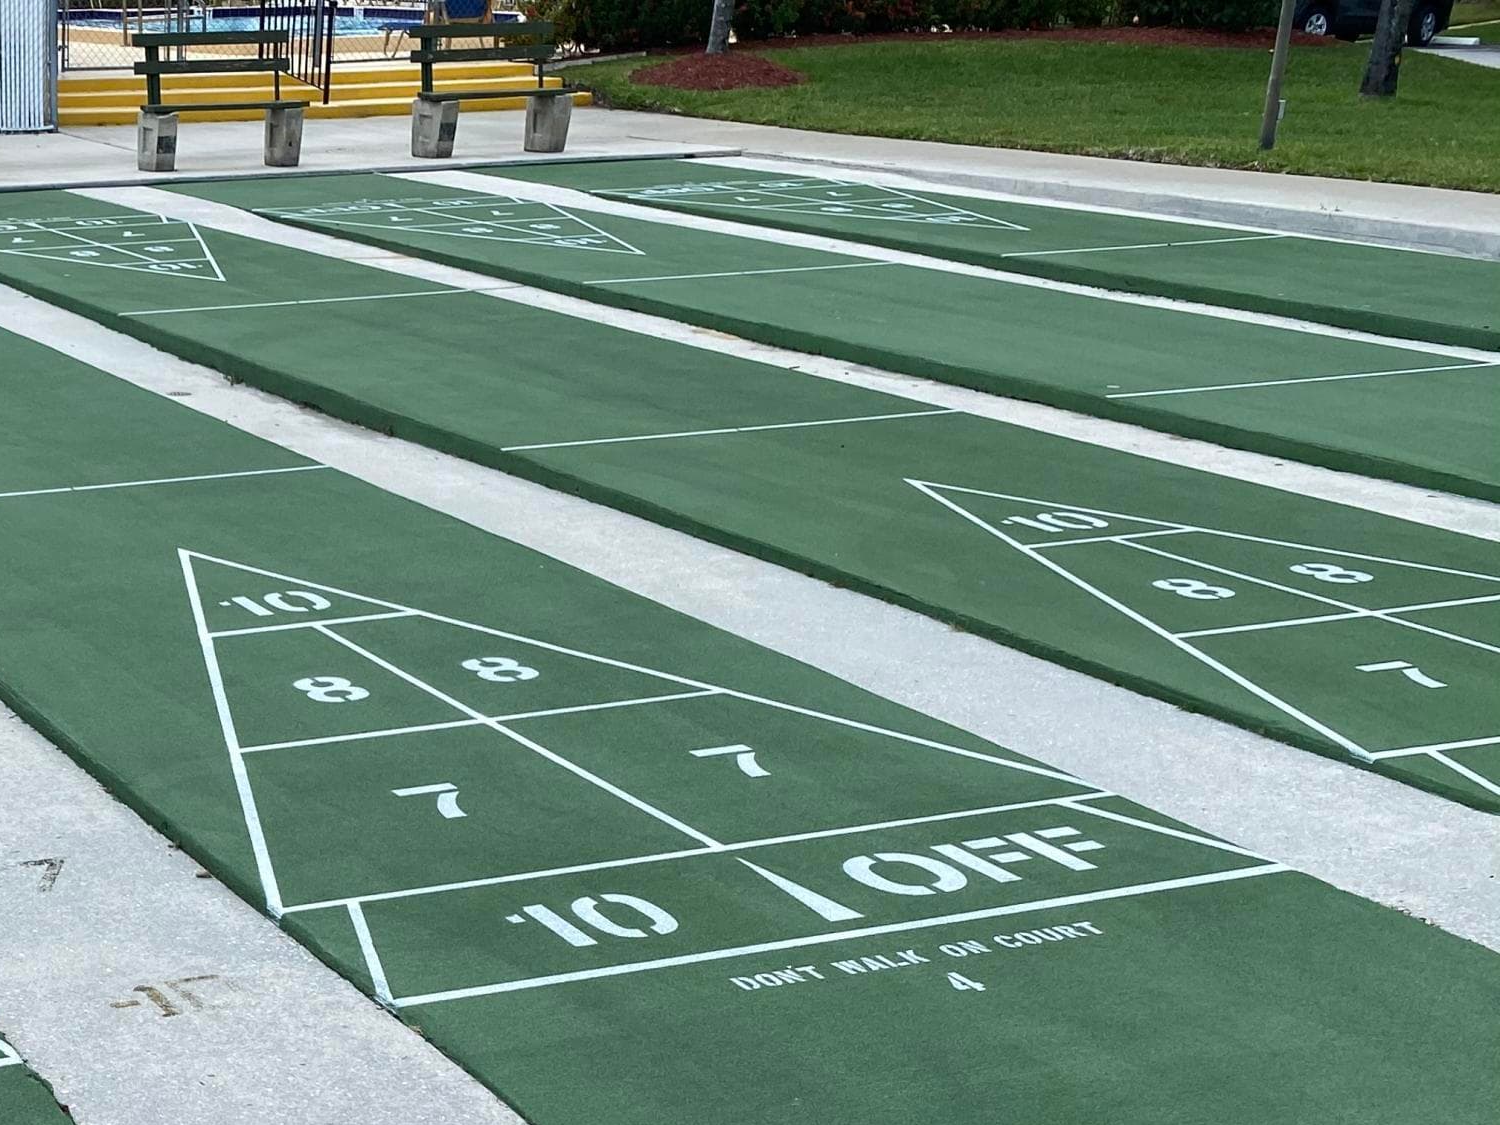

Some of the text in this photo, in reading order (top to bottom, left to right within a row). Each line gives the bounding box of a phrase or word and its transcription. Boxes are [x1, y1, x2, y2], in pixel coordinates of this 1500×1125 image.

[1002, 512, 1108, 532] 10
[1290, 564, 1373, 583] 8
[1152, 579, 1235, 599] 8
[220, 591, 331, 616] 10
[462, 657, 539, 682] 8
[1356, 661, 1447, 688] 7
[293, 677, 369, 702] 8
[689, 744, 771, 777] 7
[392, 783, 467, 818] 7
[506, 827, 1105, 946] 10 OFF
[730, 921, 1104, 990] DON'T WALK ON COURT
[948, 972, 986, 991] 4
